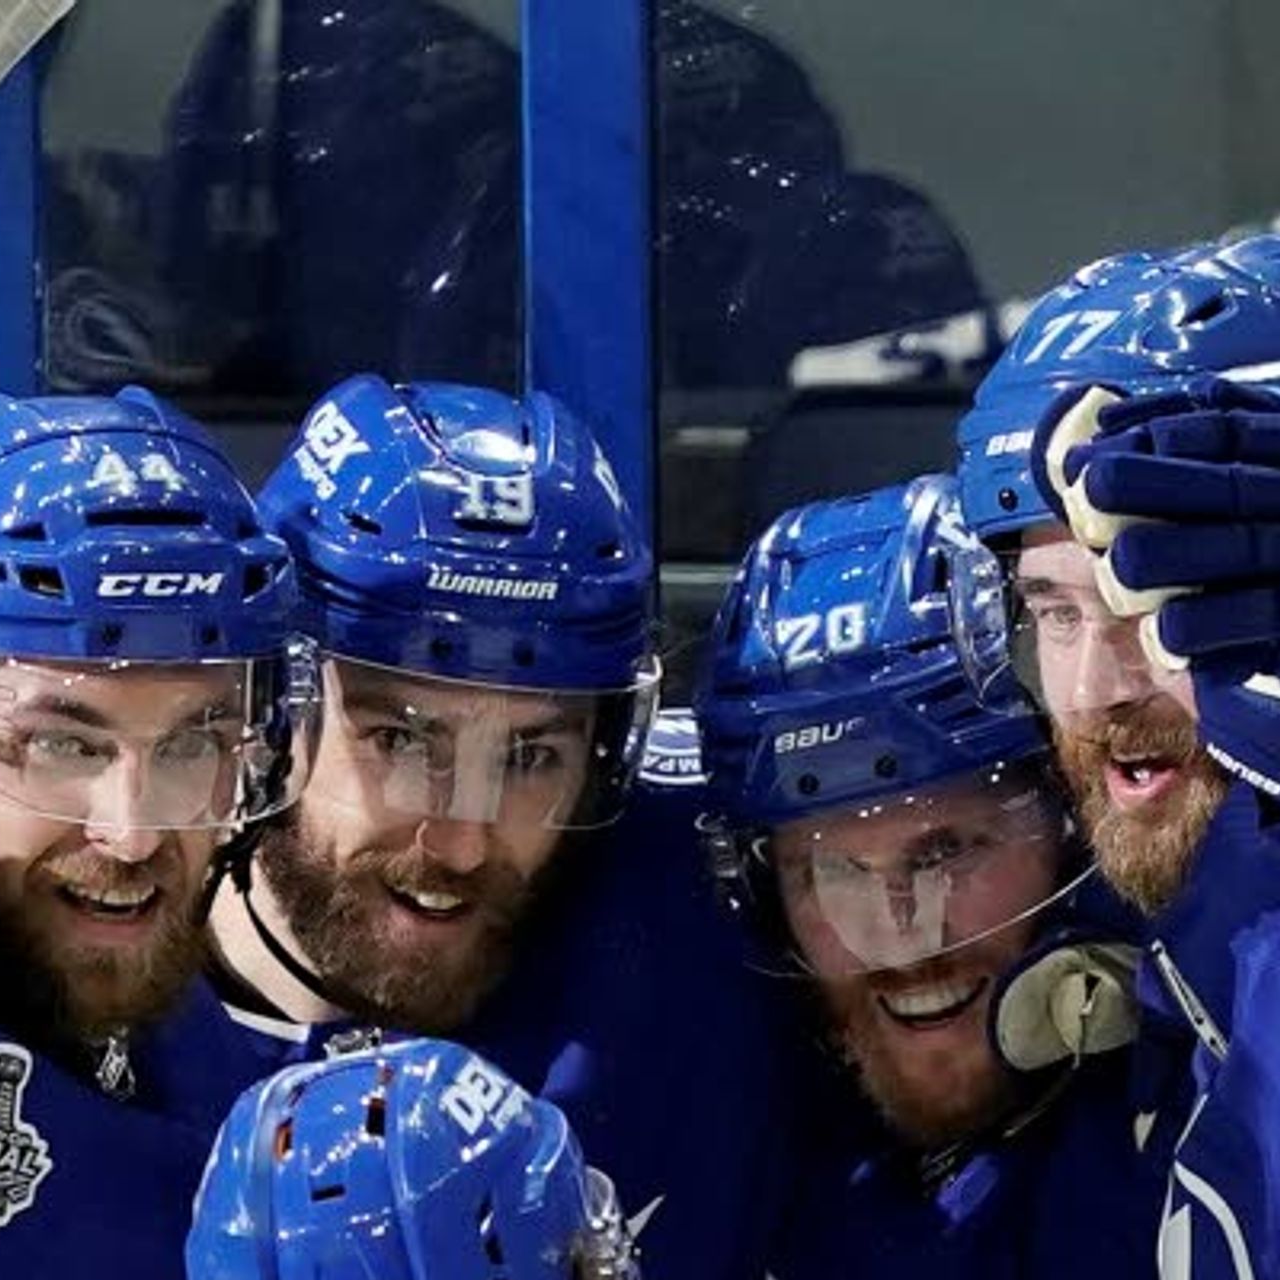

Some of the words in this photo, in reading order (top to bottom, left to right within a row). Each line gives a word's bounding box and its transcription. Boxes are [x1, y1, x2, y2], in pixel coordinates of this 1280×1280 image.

[97, 571, 225, 598] CCM
[427, 572, 560, 600] WARRIOR
[775, 602, 870, 672] 20
[774, 716, 865, 754] BAU
